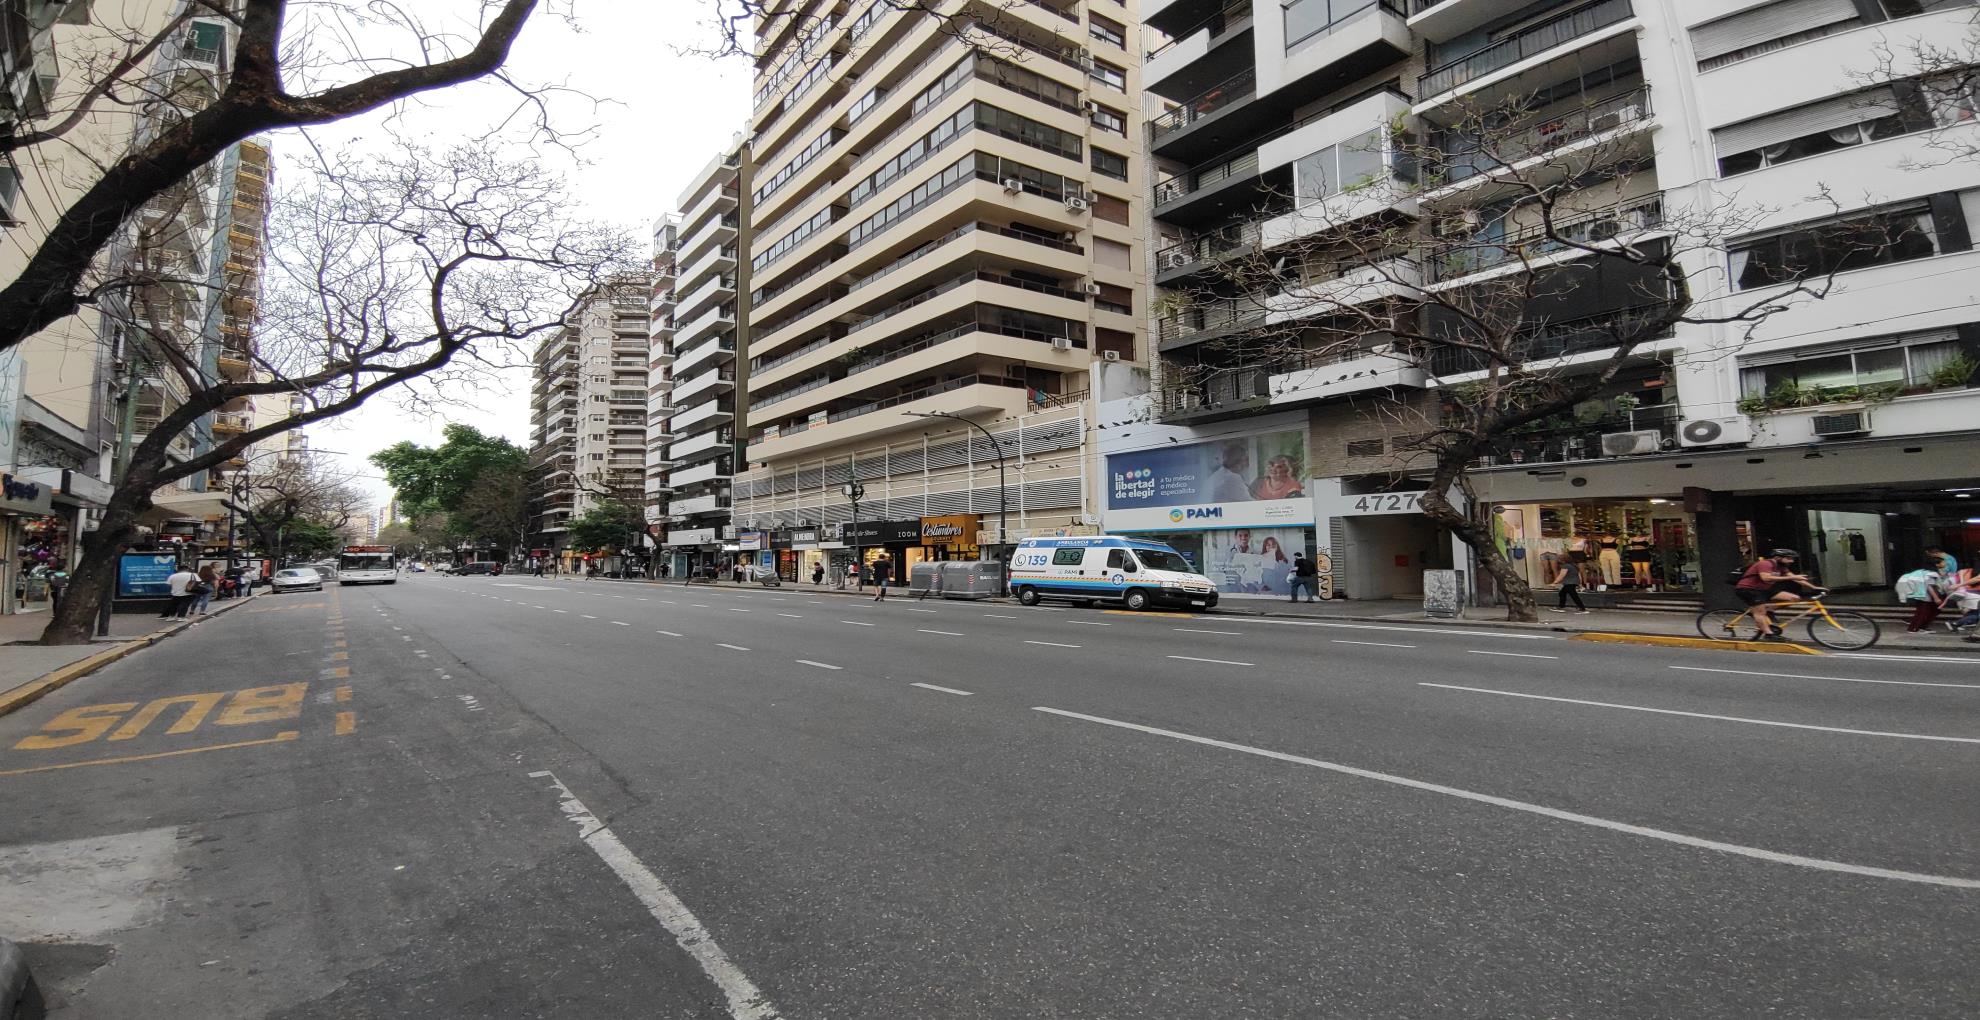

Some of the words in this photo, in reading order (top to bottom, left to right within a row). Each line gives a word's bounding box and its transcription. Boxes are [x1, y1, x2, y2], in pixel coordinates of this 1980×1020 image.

[1114, 472, 1124, 481] la
[1114, 478, 1155, 491] libertad
[1115, 491, 1127, 499] de
[1128, 488, 1155, 499] elegir
[1160, 488, 1196, 496] especialista
[1354, 493, 1418, 512] 4727
[1186, 507, 1223, 519] PAMI
[921, 521, 963, 537] Costumbres
[1027, 555, 1048, 566] 139
[13, 681, 310, 750] BUS
